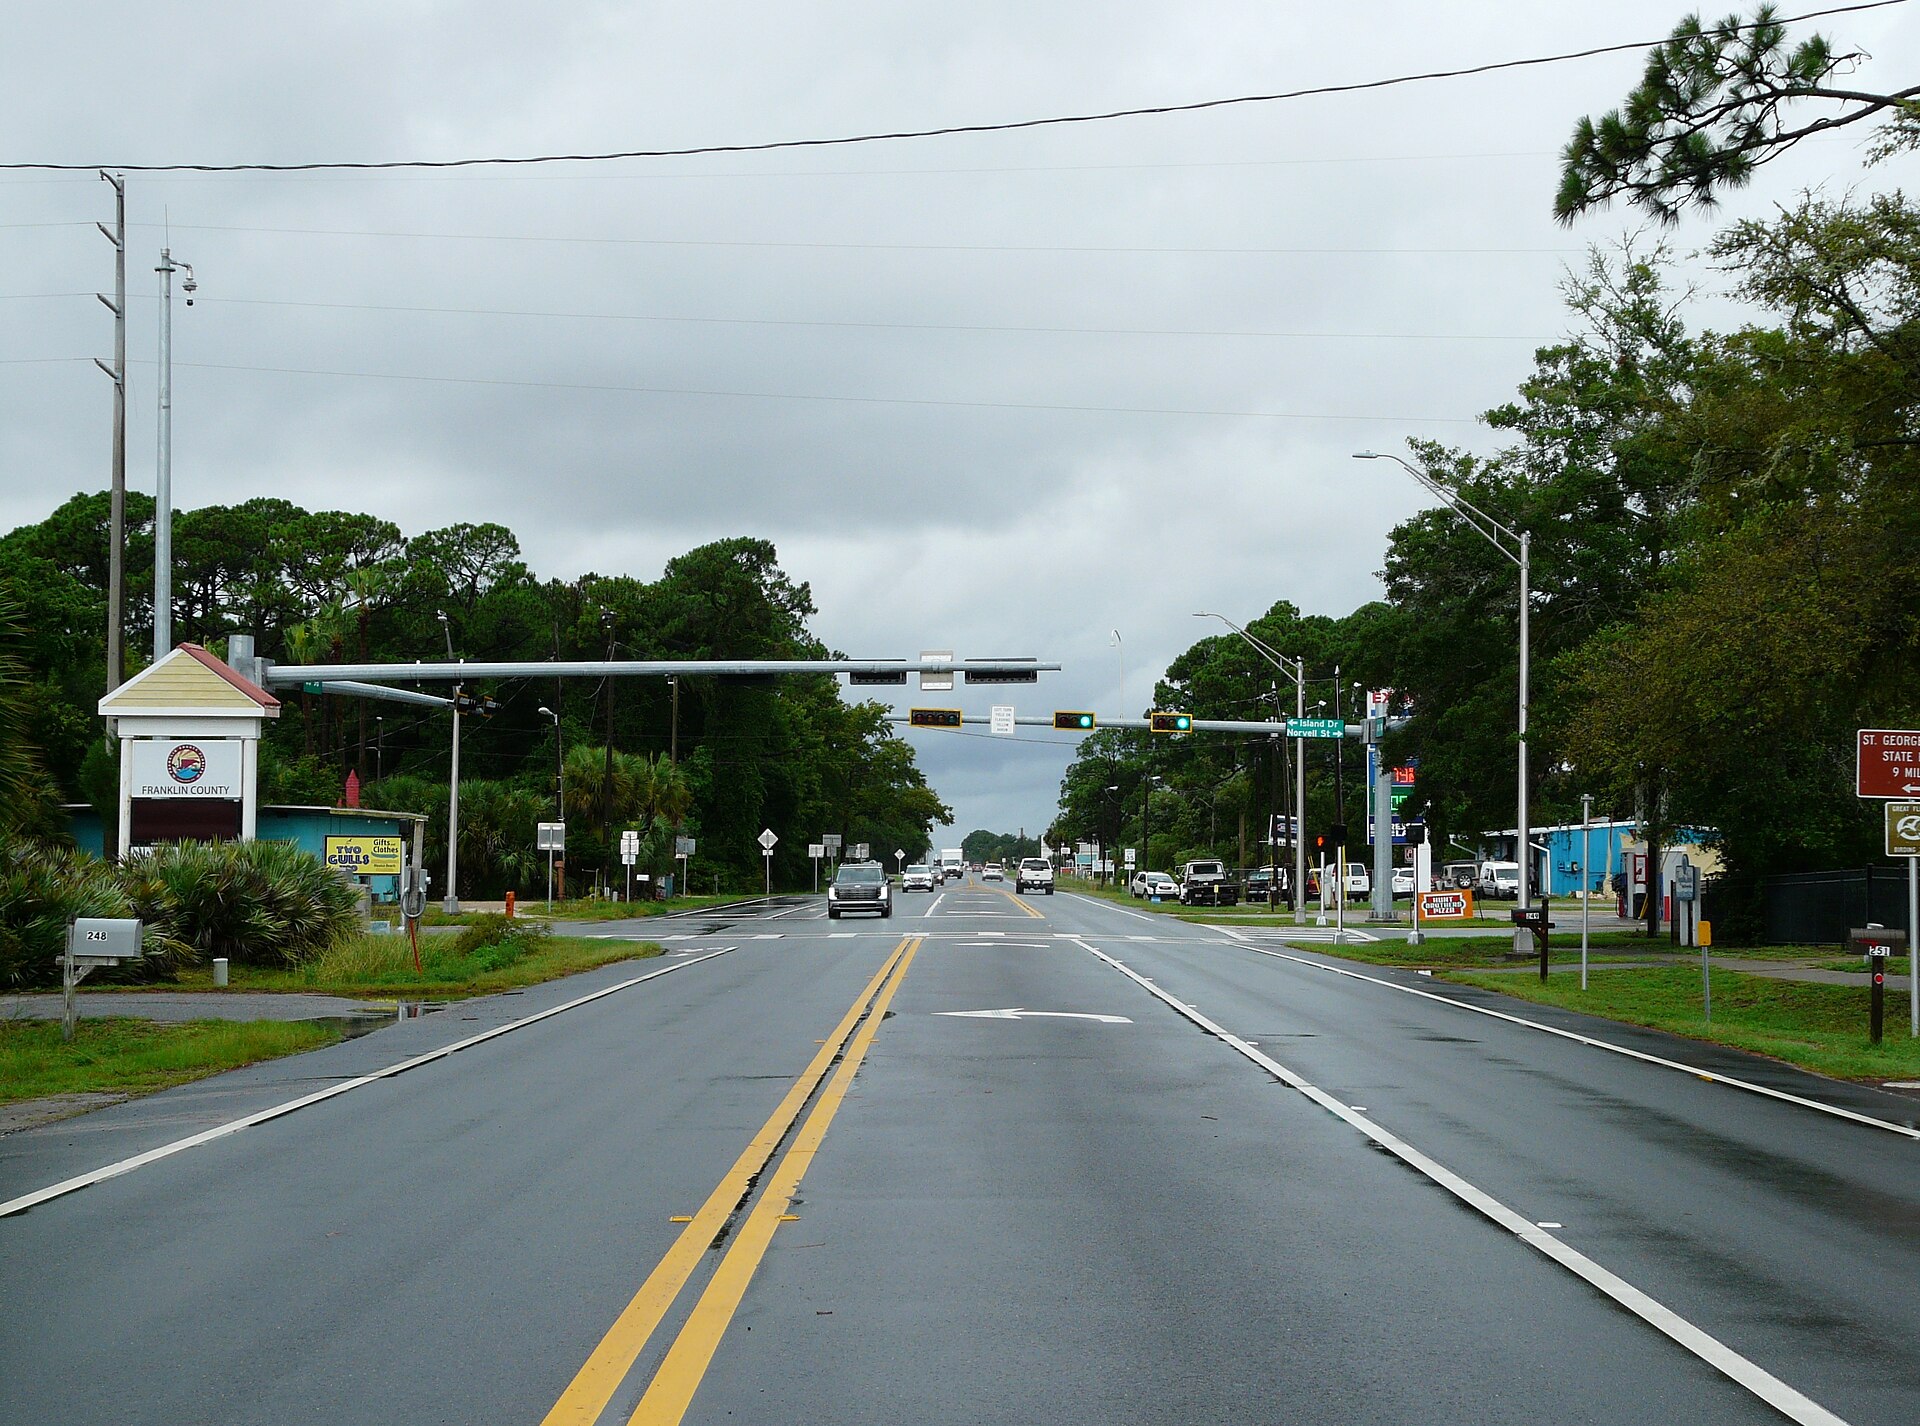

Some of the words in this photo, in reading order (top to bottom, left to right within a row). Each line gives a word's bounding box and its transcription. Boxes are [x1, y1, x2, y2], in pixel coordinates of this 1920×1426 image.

[1300, 719, 1324, 728] Island
[1327, 720, 1338, 728] Dr
[1287, 728, 1317, 737] Norvell
[1321, 729, 1330, 737] St
[1863, 735, 1877, 746] ST.
[1882, 751, 1913, 761] STATE
[1893, 767, 1900, 777] 9
[142, 786, 188, 794] FRANKLIN
[190, 786, 230, 794] COUNTY
[336, 846, 362, 854] TWO
[328, 854, 369, 865] GULLS
[1425, 901, 1462, 909] BROTHERS
[87, 931, 107, 940] 248
[1870, 947, 1888, 955] 251
